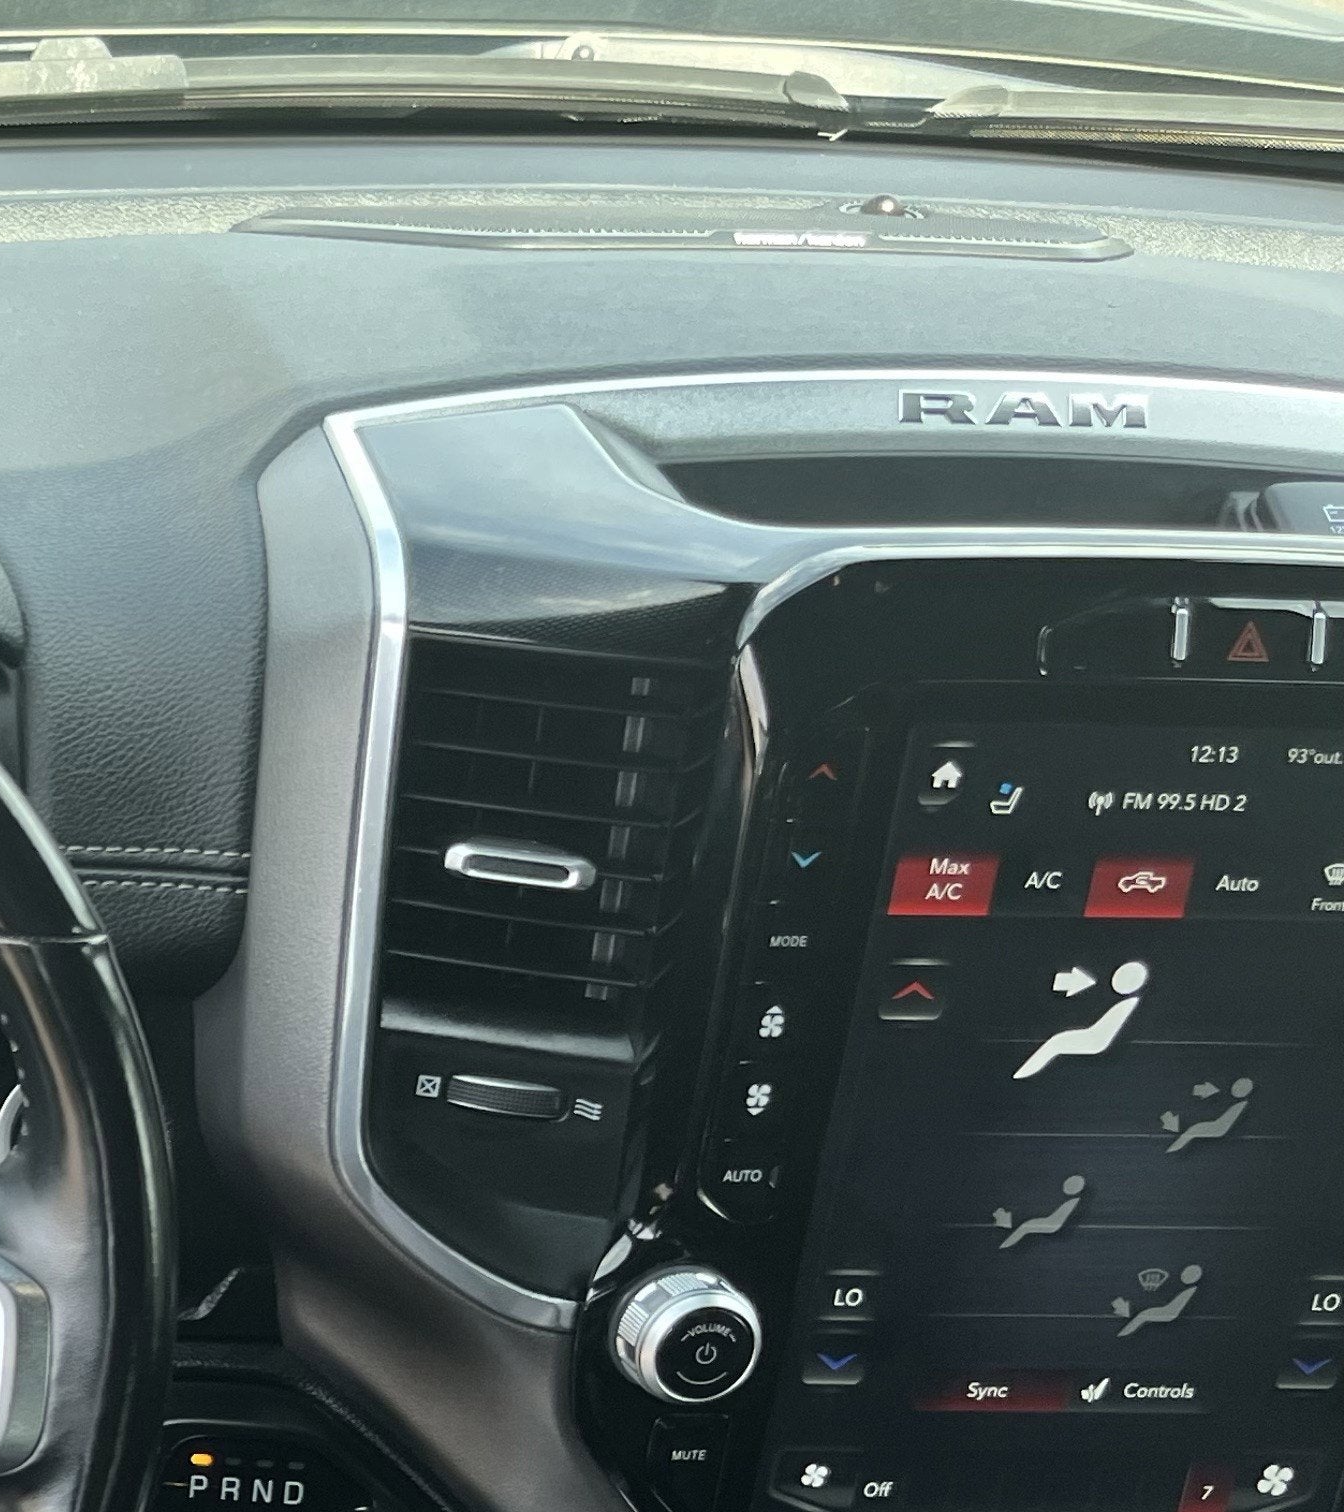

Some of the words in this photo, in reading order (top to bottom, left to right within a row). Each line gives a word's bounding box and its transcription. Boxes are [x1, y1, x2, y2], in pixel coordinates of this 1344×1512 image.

[897, 388, 1148, 429] RAM
[1189, 744, 1240, 765] 12:13
[1121, 793, 1150, 811] FM
[1157, 793, 1196, 812] 99.5
[1200, 794, 1231, 812] HD
[1233, 794, 1248, 812] 2
[928, 858, 971, 877] Max
[1024, 871, 1063, 891] A/C
[1215, 873, 1260, 893] Auto
[924, 881, 964, 902] A/C
[769, 935, 808, 948] MODE
[722, 1168, 763, 1184] AUTO
[832, 1287, 864, 1308] LO
[1310, 1292, 1341, 1312] LO
[687, 1323, 731, 1338] VOLUME
[966, 1381, 1009, 1403] Sync
[1122, 1381, 1195, 1400] Controls
[670, 1448, 707, 1462] MUTE
[188, 1474, 209, 1499] P
[219, 1476, 242, 1502] R
[251, 1479, 274, 1503] N
[283, 1480, 305, 1506] D
[862, 1479, 894, 1499] Off
[1201, 1485, 1213, 1501] 7
